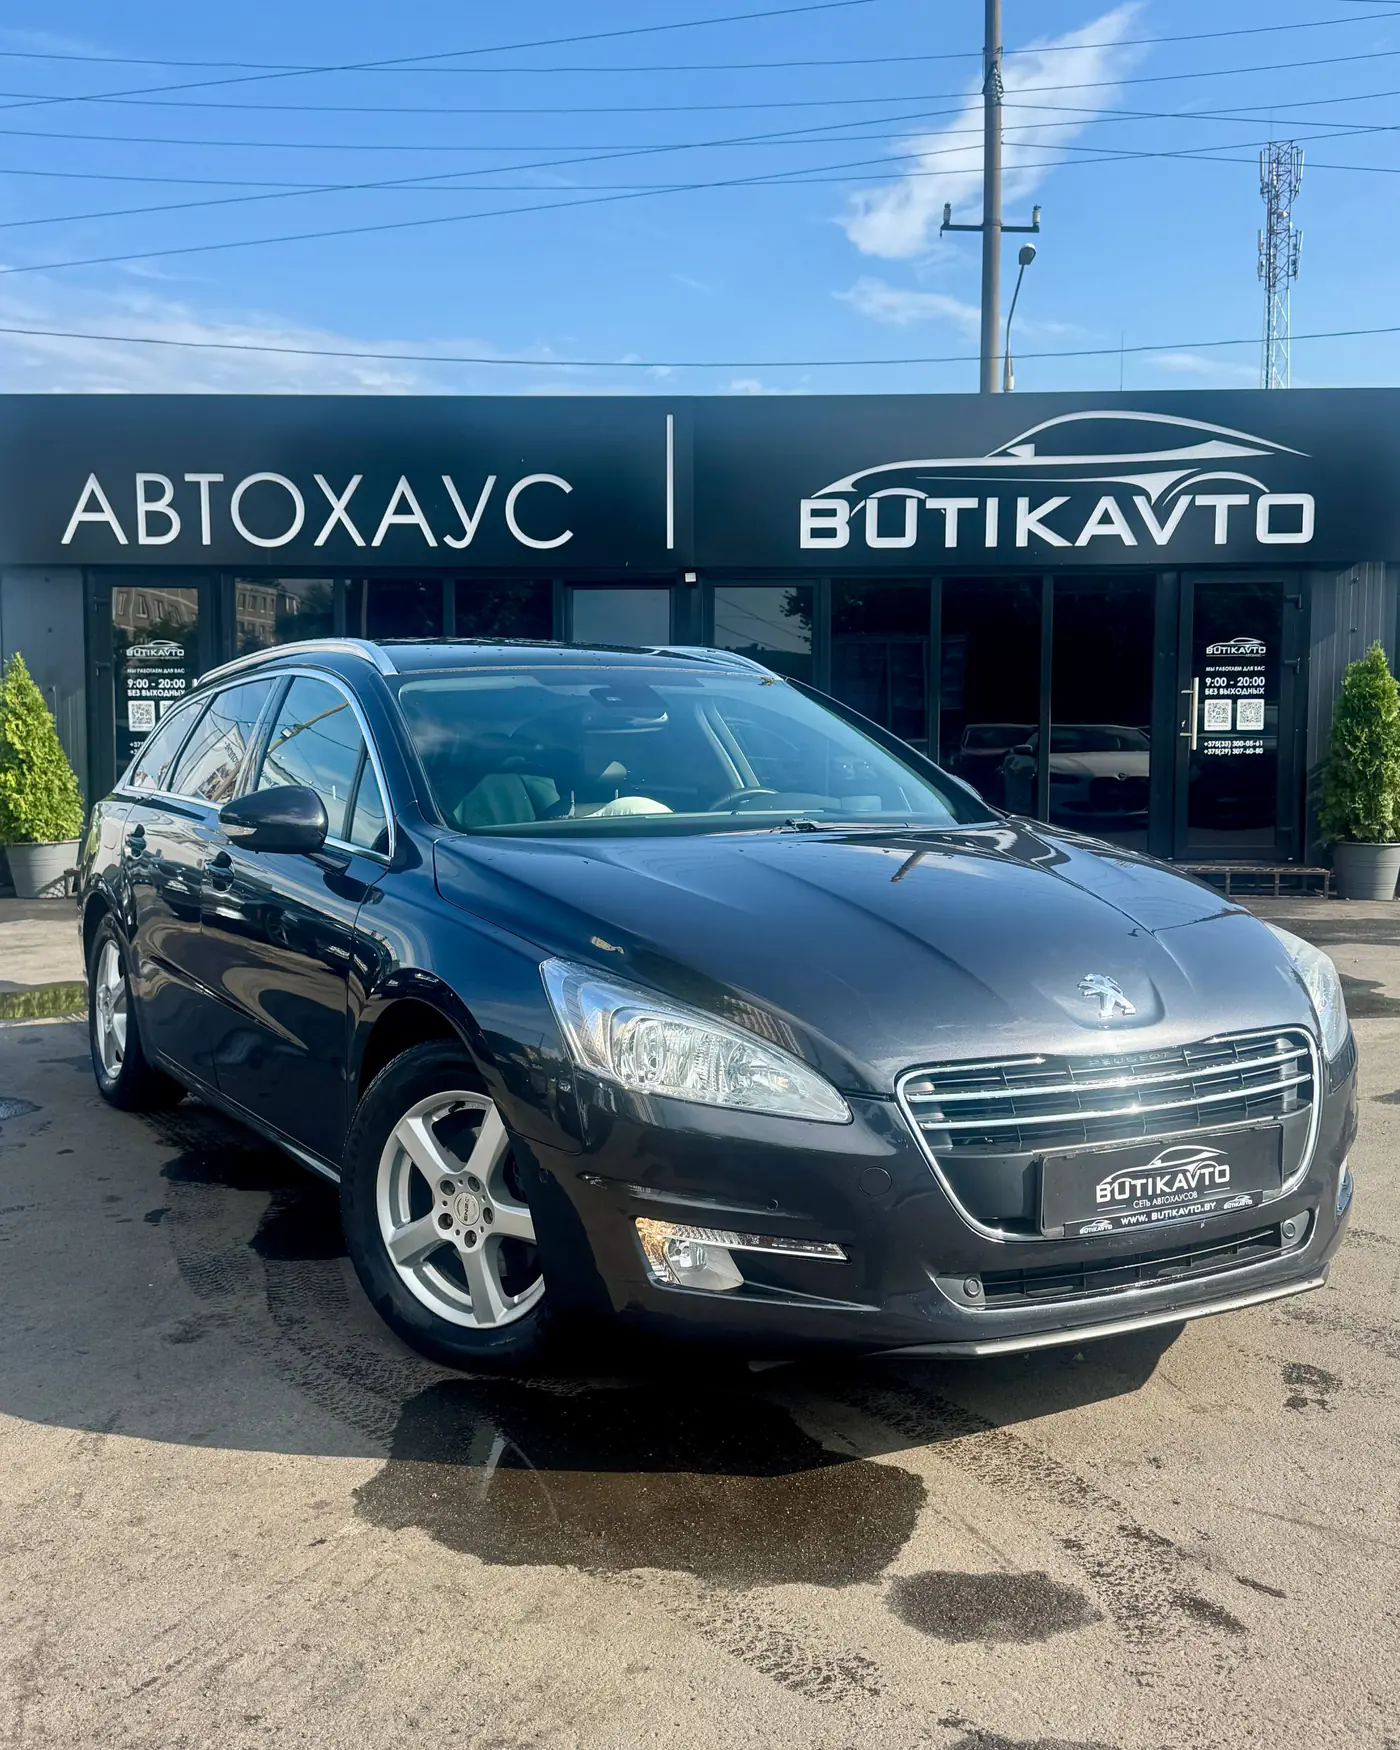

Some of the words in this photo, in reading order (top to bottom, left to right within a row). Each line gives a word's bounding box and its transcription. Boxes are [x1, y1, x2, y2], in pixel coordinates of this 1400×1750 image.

[61, 472, 573, 549] АВТОХАУС
[800, 493, 1315, 549] BUTIKAVTO
[126, 648, 185, 656] BUTIKAVTO
[1206, 646, 1266, 655] BUTIKAVTO
[127, 678, 149, 689] 9:00
[158, 678, 186, 688] 20:00
[1205, 677, 1227, 687] 9:00
[1237, 676, 1265, 686] 20:00
[127, 689, 141, 697] БЕЗ
[1205, 688, 1218, 696] БЕЗ
[1219, 687, 1265, 696] ВЫХОДНЫХ
[1203, 740, 1231, 748] +375(33)
[1232, 740, 1263, 748] 300-05-61
[1203, 748, 1231, 756] +375(29)
[1095, 1165, 1230, 1203] BUTIKAVTO
[1133, 1199, 1151, 1209] СЕТЬ
[1152, 1191, 1198, 1207] АВТОХАУСОВ
[1223, 1198, 1253, 1210] BUTIKAVTO
[1120, 1214, 1149, 1226] WWW.
[1151, 1202, 1217, 1221] BUTIKAVTO.BY
[1079, 1223, 1113, 1235] BUTIKAVTO
